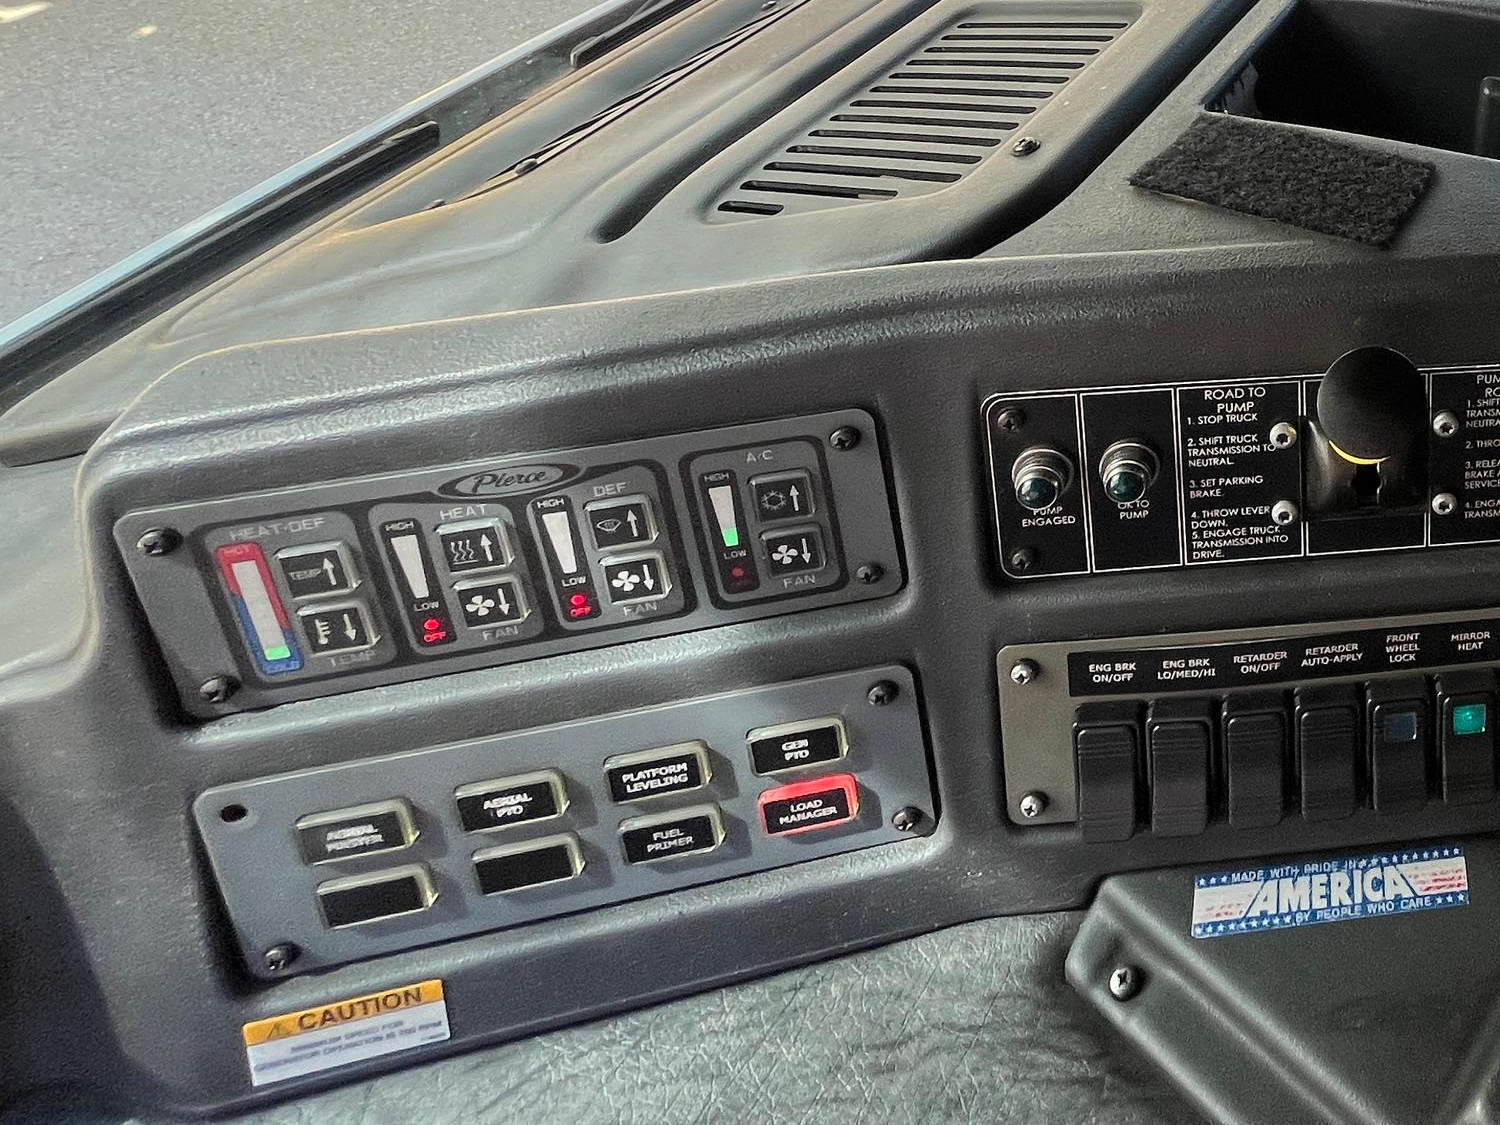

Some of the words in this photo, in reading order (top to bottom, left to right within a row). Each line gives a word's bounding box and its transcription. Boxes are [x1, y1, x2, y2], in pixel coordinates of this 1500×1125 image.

[1204, 388, 1245, 400] ROAD
[1248, 386, 1266, 397] TO
[1217, 401, 1255, 413] PUMP
[1477, 397, 1500, 407] SHIFT
[1187, 417, 1195, 425] 1.
[1197, 414, 1223, 425] STOP
[1226, 413, 1258, 423] TRUCK
[1187, 438, 1196, 447] 2.
[1199, 436, 1223, 446] SHIFT
[1226, 434, 1258, 444] TRUCK
[1465, 440, 1474, 449] 2.
[1187, 444, 1260, 457] TRANSMISSION
[1263, 443, 1277, 452] TO
[1465, 461, 1473, 469] 3.
[1465, 469, 1495, 479] BRAKE
[471, 471, 546, 494] Pierce
[1189, 480, 1198, 488] 3.
[1200, 478, 1216, 488] SET
[1219, 475, 1264, 486] PARKING
[593, 482, 627, 497] DEF
[536, 498, 565, 509] HIGH
[1135, 499, 1150, 508] TO
[439, 503, 487, 521] HEAT
[1033, 506, 1063, 516] PUMP
[1120, 509, 1149, 520] PUMP
[1191, 511, 1200, 519] 4.
[1202, 507, 1239, 519] THROW
[1241, 506, 1270, 516] LEVER
[385, 521, 414, 532] HIGH
[1022, 515, 1076, 527] ENGAGED
[1191, 519, 1228, 530] DOWN.
[1192, 531, 1200, 540] 5.
[1203, 527, 1247, 539] ENGAGE
[1250, 526, 1281, 535] TRUCK
[1192, 536, 1263, 550] TRANSMISSION
[1265, 535, 1289, 544] INTO
[723, 549, 747, 560] LOW
[1193, 550, 1225, 560] DRIVE.
[561, 576, 587, 588] LOW
[783, 575, 816, 589] FAN
[413, 601, 440, 612] LOW
[570, 606, 593, 618] OFF
[623, 602, 658, 617] FAN
[423, 631, 447, 643] OFF
[481, 625, 519, 640] FAN
[1386, 632, 1420, 643] FRONT
[1450, 631, 1491, 642] MIRROR
[1305, 643, 1359, 656] RETARDER
[1385, 643, 1421, 654] WHEEL
[1458, 641, 1483, 651] HEAT
[327, 650, 378, 668] TEMP
[1162, 660, 1185, 669] ENG
[1188, 658, 1210, 668] BRK
[1233, 651, 1288, 664] RETARDER
[1301, 652, 1363, 667] AUTO-APPLY
[1389, 653, 1416, 664] LOCK
[1088, 663, 1112, 673] ENG
[1114, 662, 1137, 671] BRK
[1157, 667, 1216, 680] LO/MED/HI
[1240, 662, 1281, 674] ON/OFF
[1092, 672, 1134, 683] ON/OFF
[781, 738, 809, 752] GEN
[784, 749, 810, 761] PTO
[621, 762, 688, 784] PLATFORM
[626, 773, 689, 794] LEVELING
[790, 798, 824, 814] LOAD
[778, 806, 838, 825] MANAGER
[652, 827, 685, 842] FUEL
[646, 835, 695, 853] PRIMER
[1231, 870, 1265, 883] MADE
[1270, 865, 1300, 879] WITH
[1344, 859, 1357, 872] IN
[1247, 866, 1413, 917] AMERICA
[1296, 911, 1310, 925] BY
[1316, 905, 1362, 921] PEOPLE
[1366, 901, 1395, 915] WHO
[1401, 896, 1432, 909] CARE
[297, 987, 422, 1031] CAUTION
